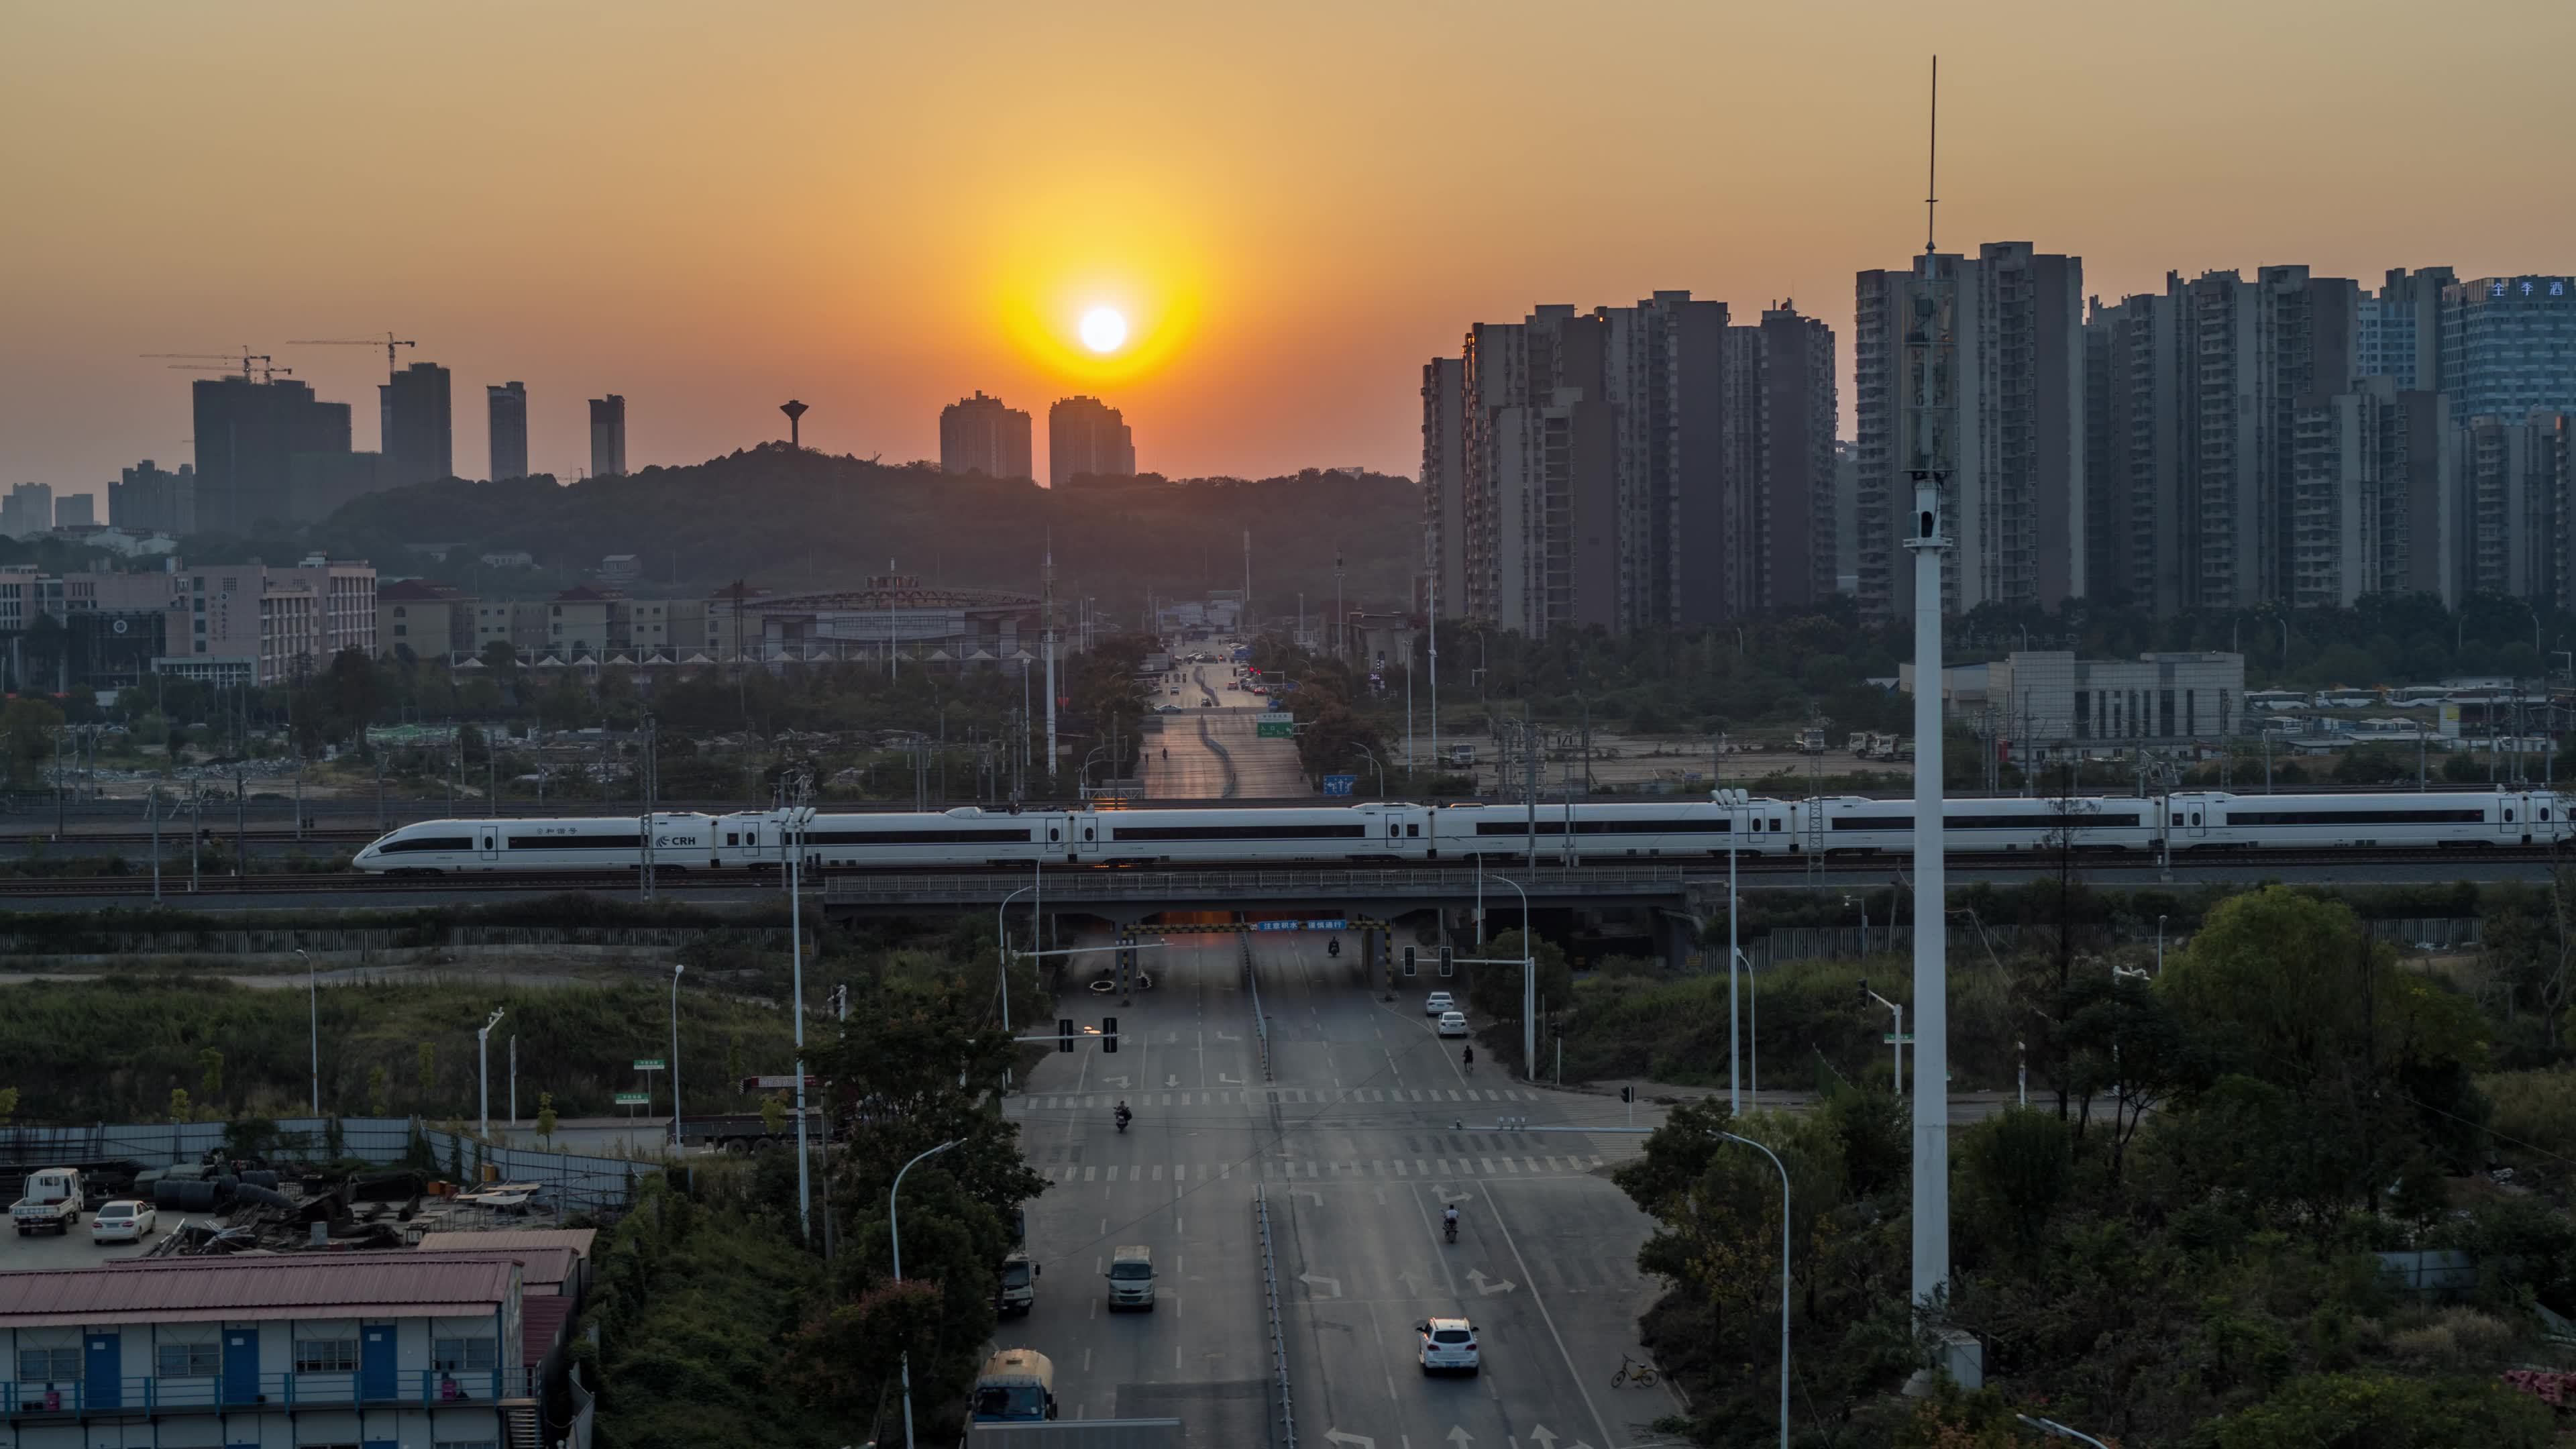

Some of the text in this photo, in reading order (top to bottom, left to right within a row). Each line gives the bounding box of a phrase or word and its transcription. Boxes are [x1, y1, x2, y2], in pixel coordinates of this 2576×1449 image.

[2492, 281, 2563, 297] 全季酒
[672, 837, 696, 845] CRH
[1264, 922, 1297, 930] 注意积水
